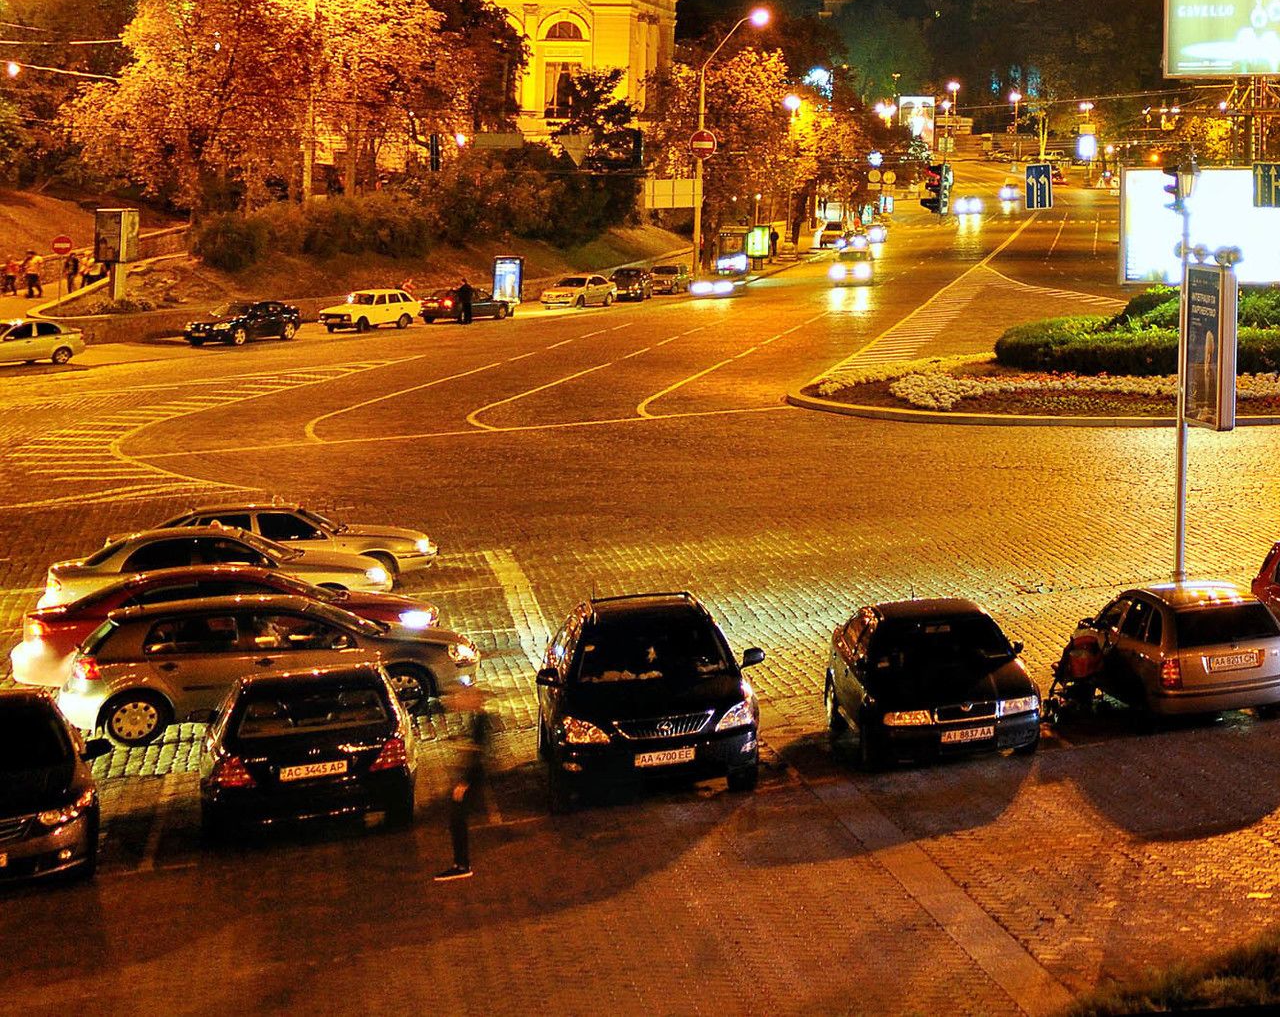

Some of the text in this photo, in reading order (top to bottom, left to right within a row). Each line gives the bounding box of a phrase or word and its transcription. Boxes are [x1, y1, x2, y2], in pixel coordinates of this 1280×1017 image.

[641, 750, 692, 763] AA 4700 EE
[286, 762, 345, 778] AC 3445 AP
